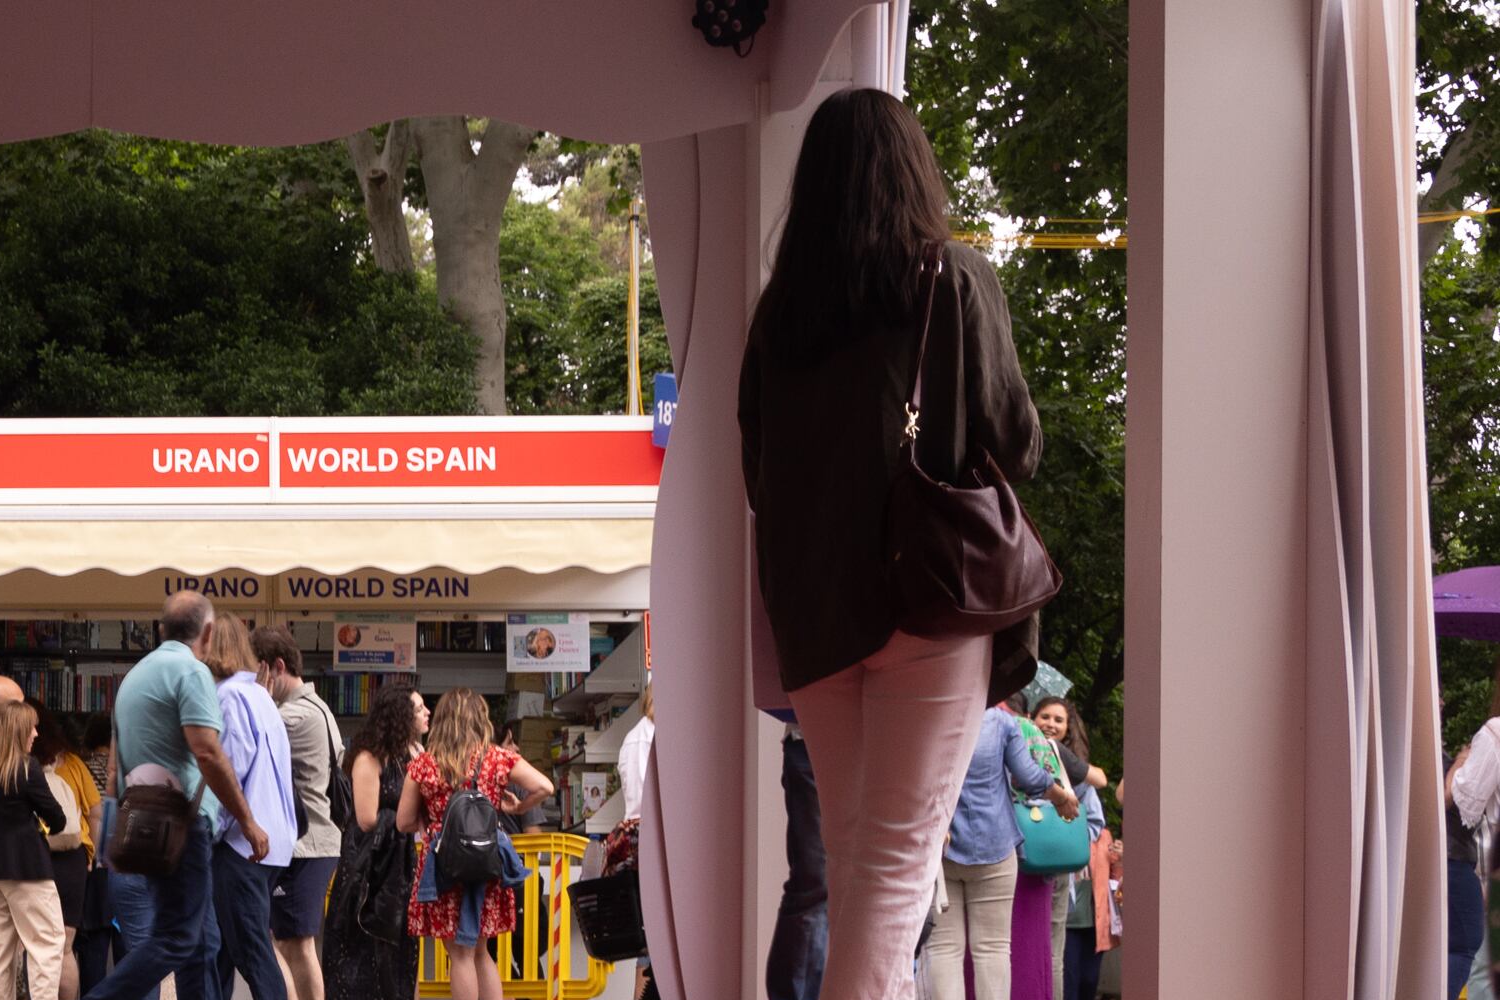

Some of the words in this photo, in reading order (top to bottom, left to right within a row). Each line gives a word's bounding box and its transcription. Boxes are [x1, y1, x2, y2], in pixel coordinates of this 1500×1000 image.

[153, 448, 260, 473] URANO
[287, 447, 399, 472] WORLD
[406, 446, 496, 472] SPAIN
[288, 576, 385, 598] WORLD
[391, 576, 470, 597] SPAIN
